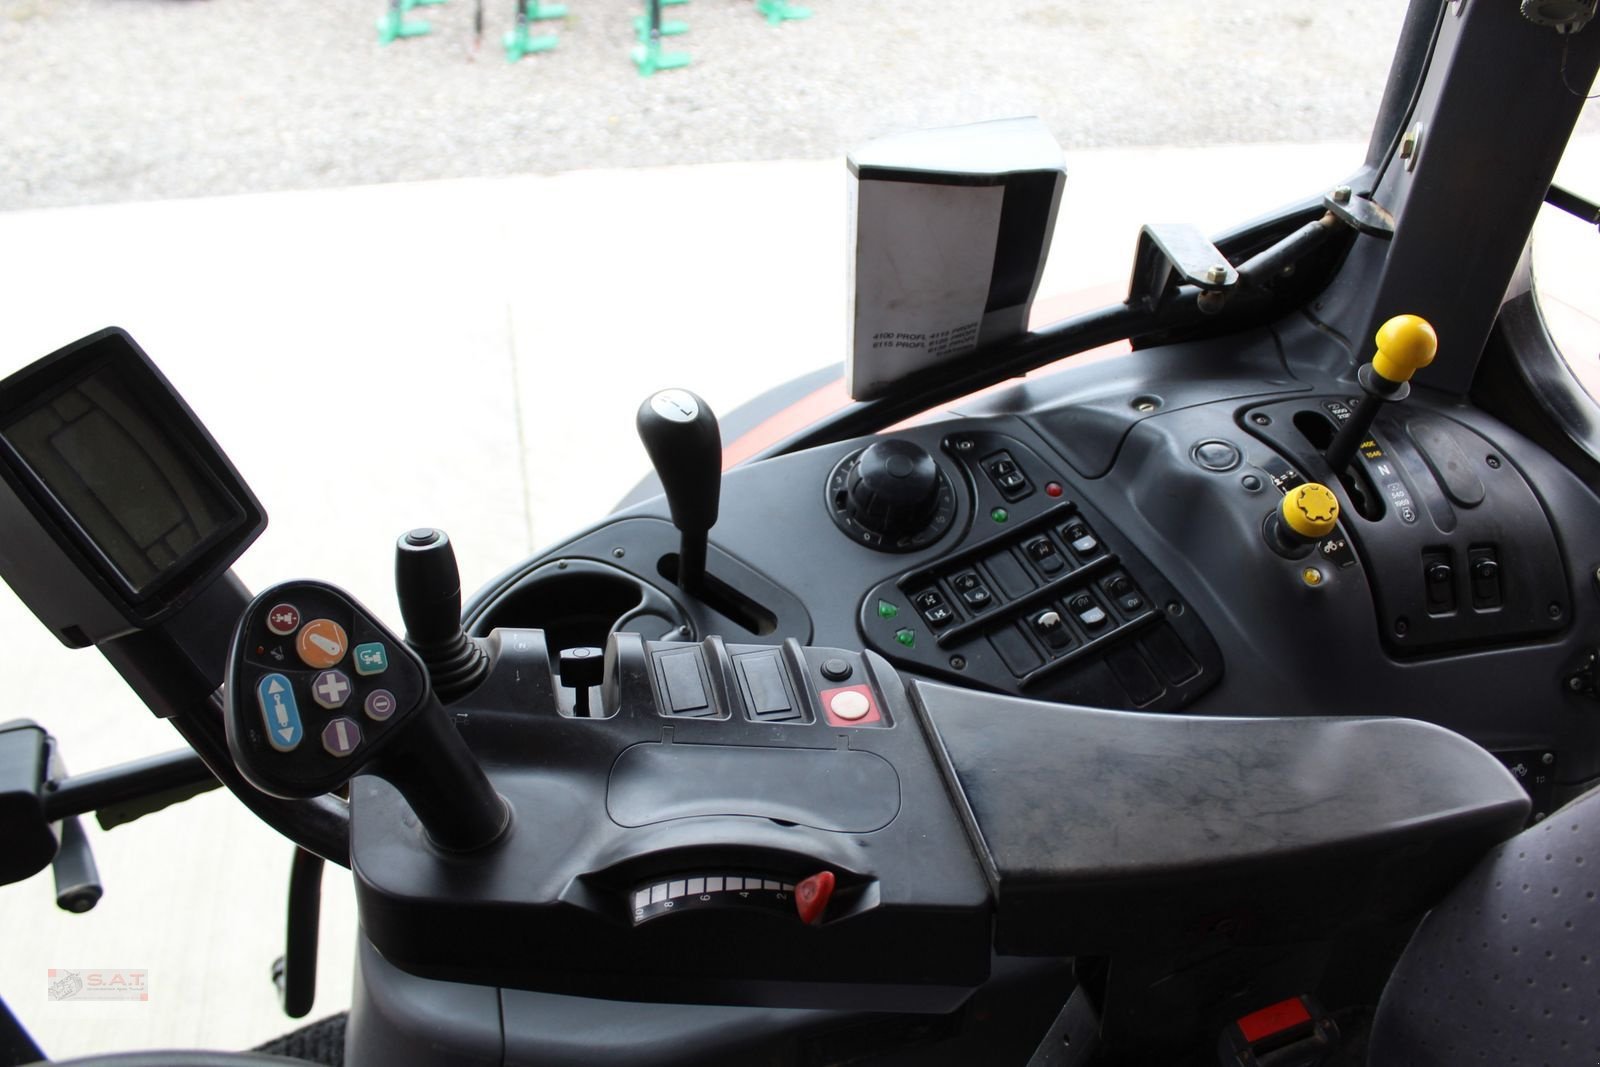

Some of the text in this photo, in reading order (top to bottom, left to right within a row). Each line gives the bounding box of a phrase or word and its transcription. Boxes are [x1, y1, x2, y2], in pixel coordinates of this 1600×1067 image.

[1378, 465, 1390, 475] N
[699, 893, 711, 902] 6
[663, 900, 674, 909] 8
